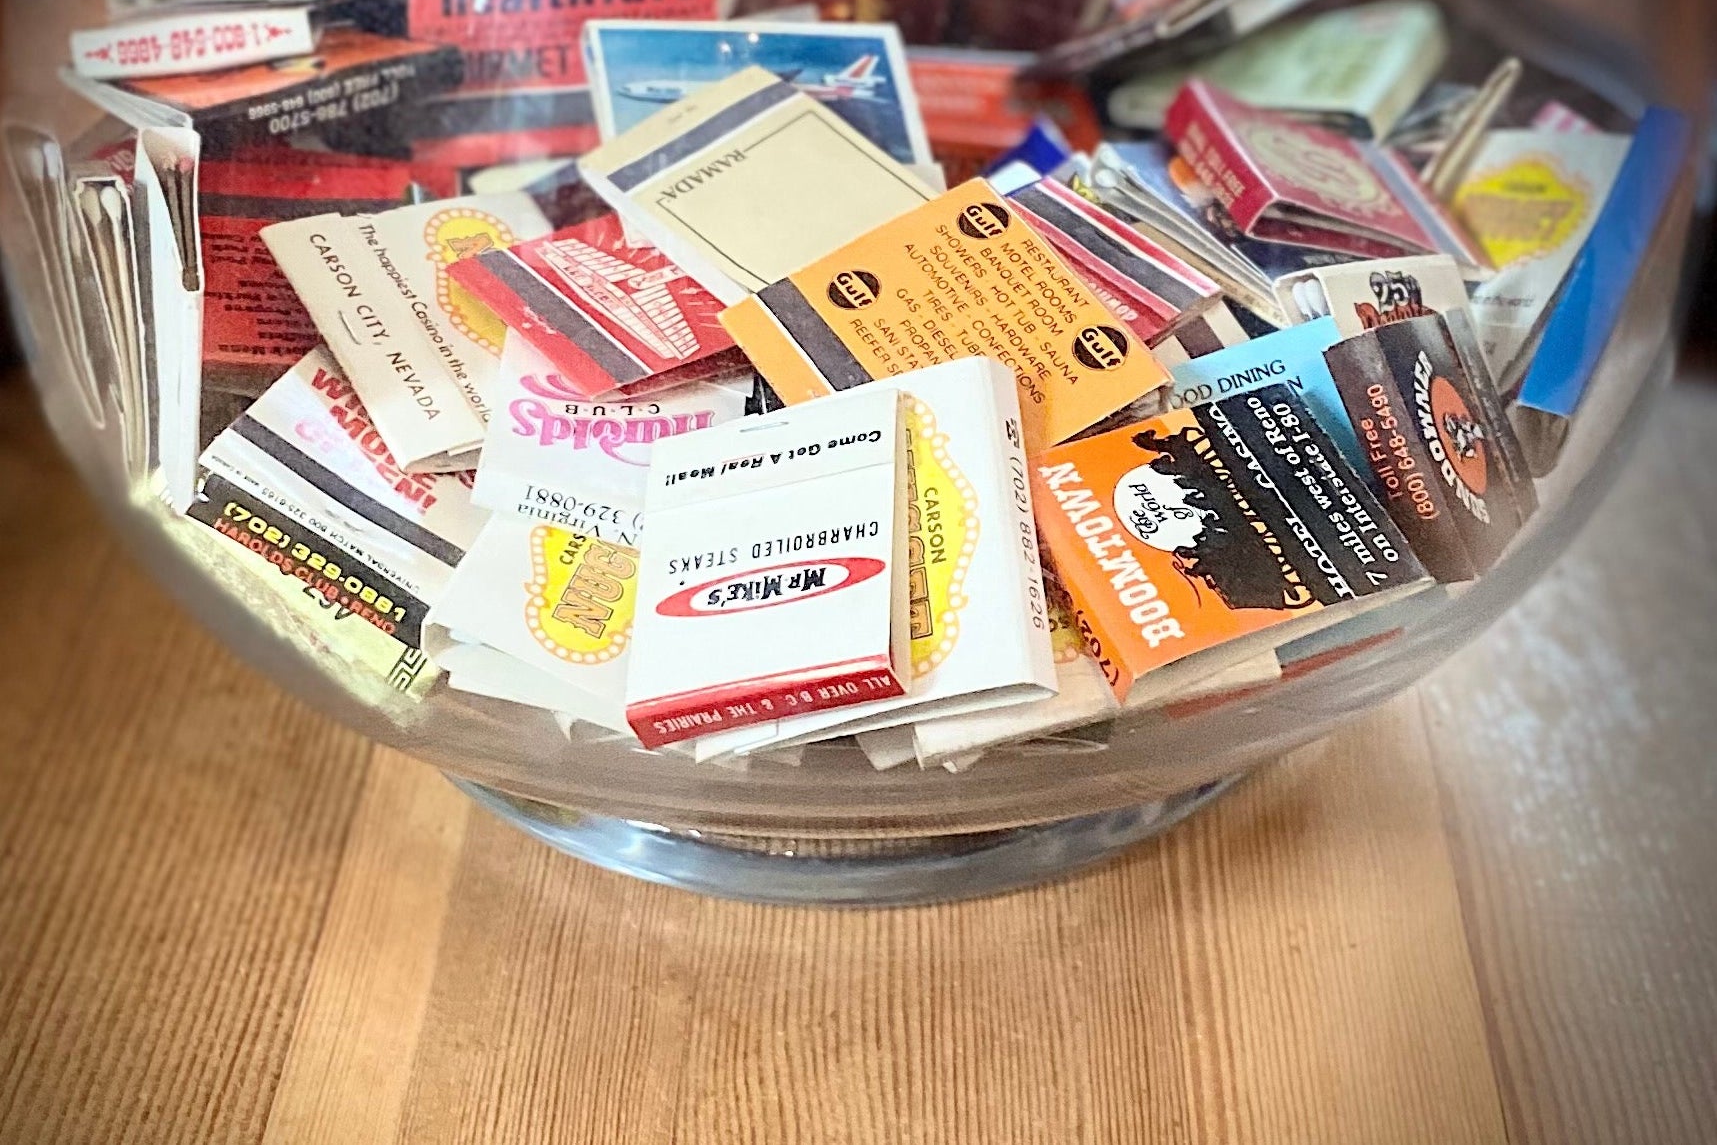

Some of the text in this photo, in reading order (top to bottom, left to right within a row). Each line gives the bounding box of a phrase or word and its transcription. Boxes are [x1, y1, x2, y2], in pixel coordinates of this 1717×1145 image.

[465, 45, 568, 79] URMET
[662, 148, 747, 201] RAMADA
[966, 204, 1002, 238] Gulf
[836, 271, 869, 307] Gulf
[979, 247, 1064, 336] BANQUET ROOM
[1000, 242, 1078, 324] MOTEL ROOMS
[1021, 238, 1089, 309] RESTAURANT
[309, 233, 360, 298] CARSON
[386, 352, 441, 421] NEVADA
[359, 225, 381, 250] The
[375, 246, 416, 303] happiest
[411, 301, 445, 350] Casino
[445, 358, 466, 383] the
[897, 288, 960, 362] GAS DIESEL
[904, 243, 1046, 404] AUTOMOTIVE CONFECTIONS
[922, 289, 987, 361] TIRES TUBE
[929, 245, 1051, 381] SOUVENIRS HARDWARE
[935, 224, 1079, 386] SHOWERS HOT TUB SAUNA
[849, 318, 892, 367] REEFER
[874, 318, 926, 371] SANI STA
[900, 319, 941, 367] PROPAN
[1080, 327, 1121, 368] Gulf
[1168, 382, 1210, 409] OOD
[1217, 360, 1287, 399] DINING
[828, 429, 881, 450] Come
[1248, 397, 1297, 452] Reno
[1272, 403, 1312, 454] I-80
[1360, 417, 1388, 464] Free
[665, 464, 716, 486] Meal!
[720, 456, 765, 472] Real
[770, 453, 780, 464] A
[1366, 384, 1437, 521] (800) 648-5490
[1128, 484, 1170, 522] world
[1307, 477, 1341, 529] west
[1312, 447, 1380, 540] Interstate
[223, 501, 291, 550] (702)
[517, 503, 601, 542] Virginia
[667, 521, 880, 575] CHARBROILED STEAKS
[923, 486, 947, 564] CARSON
[1010, 455, 1045, 631] (702) 882-1626
[1039, 461, 1187, 649] BOOMTOWN
[1335, 525, 1375, 576] miles
[1378, 534, 1399, 563] on
[213, 518, 292, 576] HAROLDS
[290, 563, 340, 603] CLUB
[348, 597, 397, 635] RENO
[552, 544, 640, 639] NUG
[729, 701, 758, 718] THE
[762, 697, 773, 710] &
[817, 681, 856, 701] OVER
[860, 675, 891, 693] ALL
[654, 708, 723, 733] PRAIRIES
